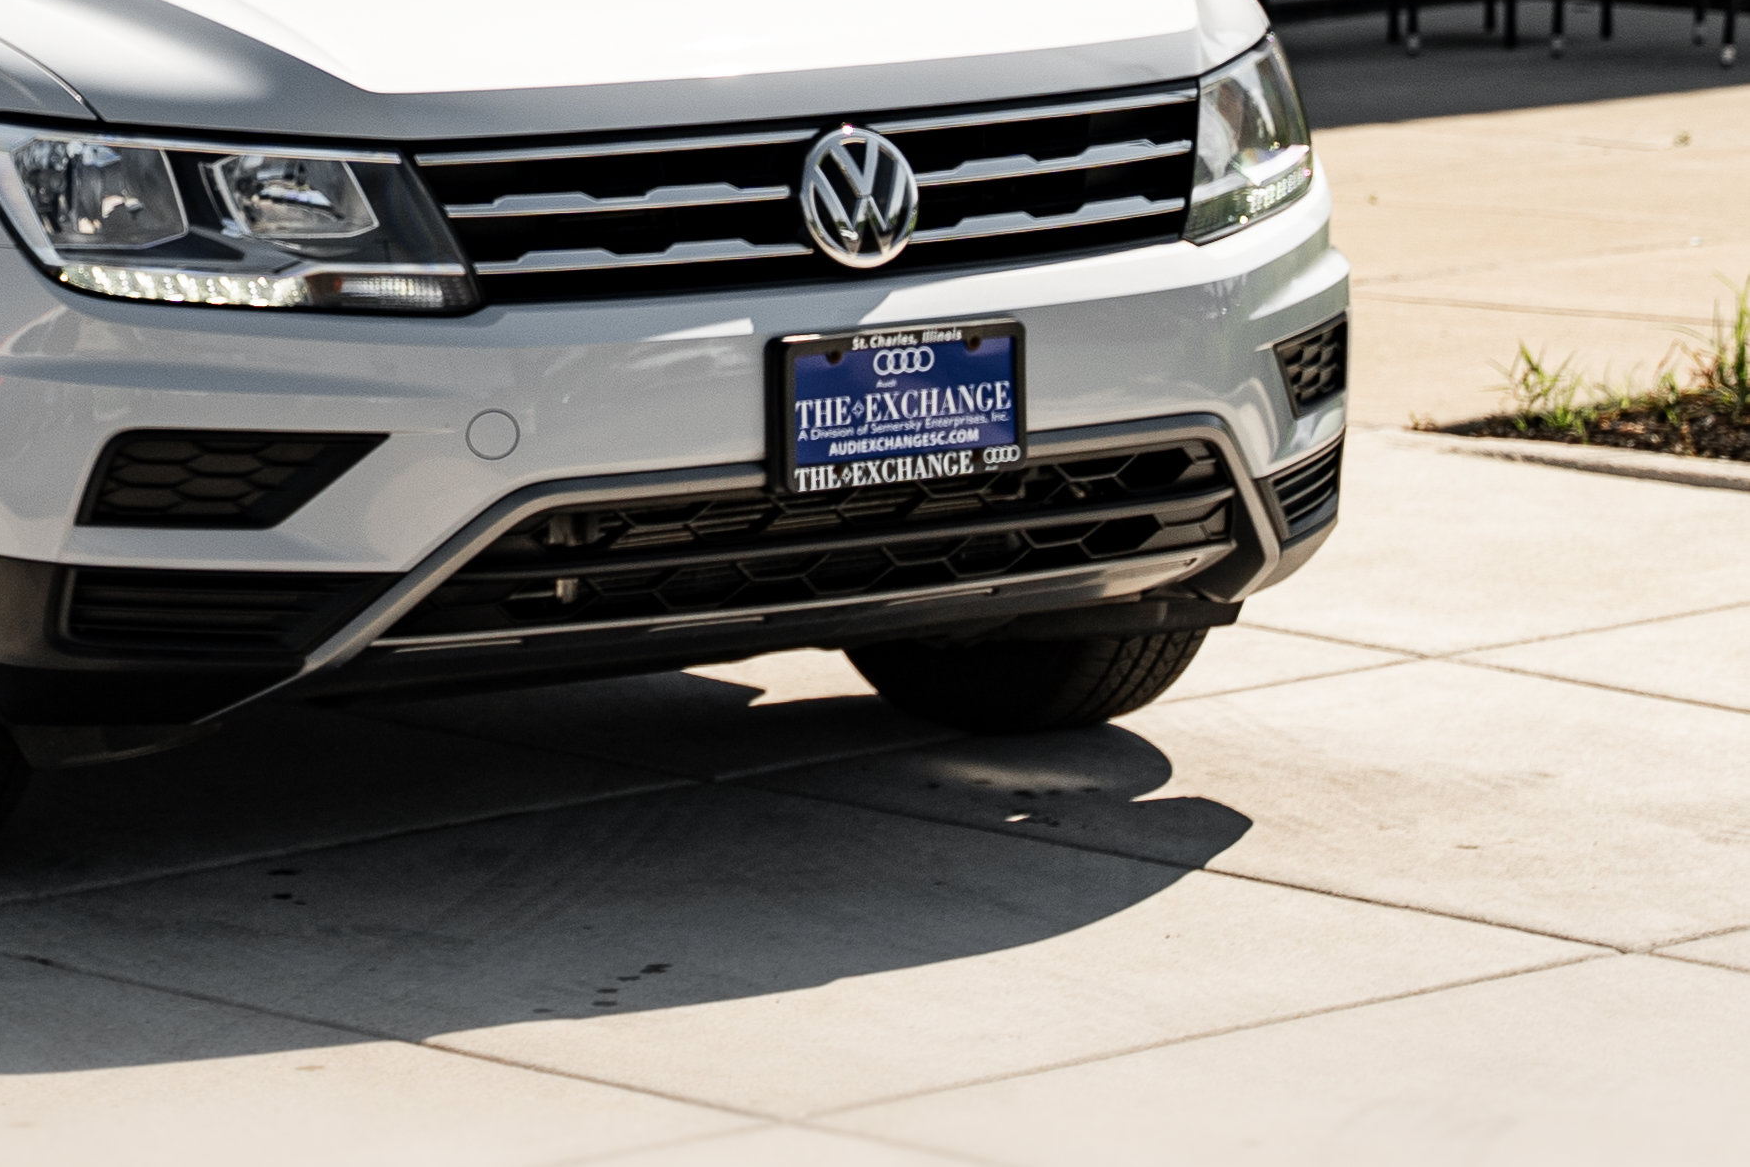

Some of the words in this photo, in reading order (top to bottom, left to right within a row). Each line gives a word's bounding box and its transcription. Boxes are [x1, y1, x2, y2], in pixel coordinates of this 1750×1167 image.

[852, 336, 868, 350] St.
[870, 332, 918, 348] Charles,
[922, 328, 962, 343] Illinois
[795, 396, 851, 429] THE
[865, 381, 1011, 423] EXCHANGE
[797, 430, 808, 442] A
[810, 426, 854, 441] Division
[856, 424, 869, 436] of
[991, 411, 1010, 422] Inc.
[828, 428, 980, 456] AUDIEXCHANGESC.COM
[794, 466, 842, 492] THE
[851, 449, 974, 486] EXCHANGE
